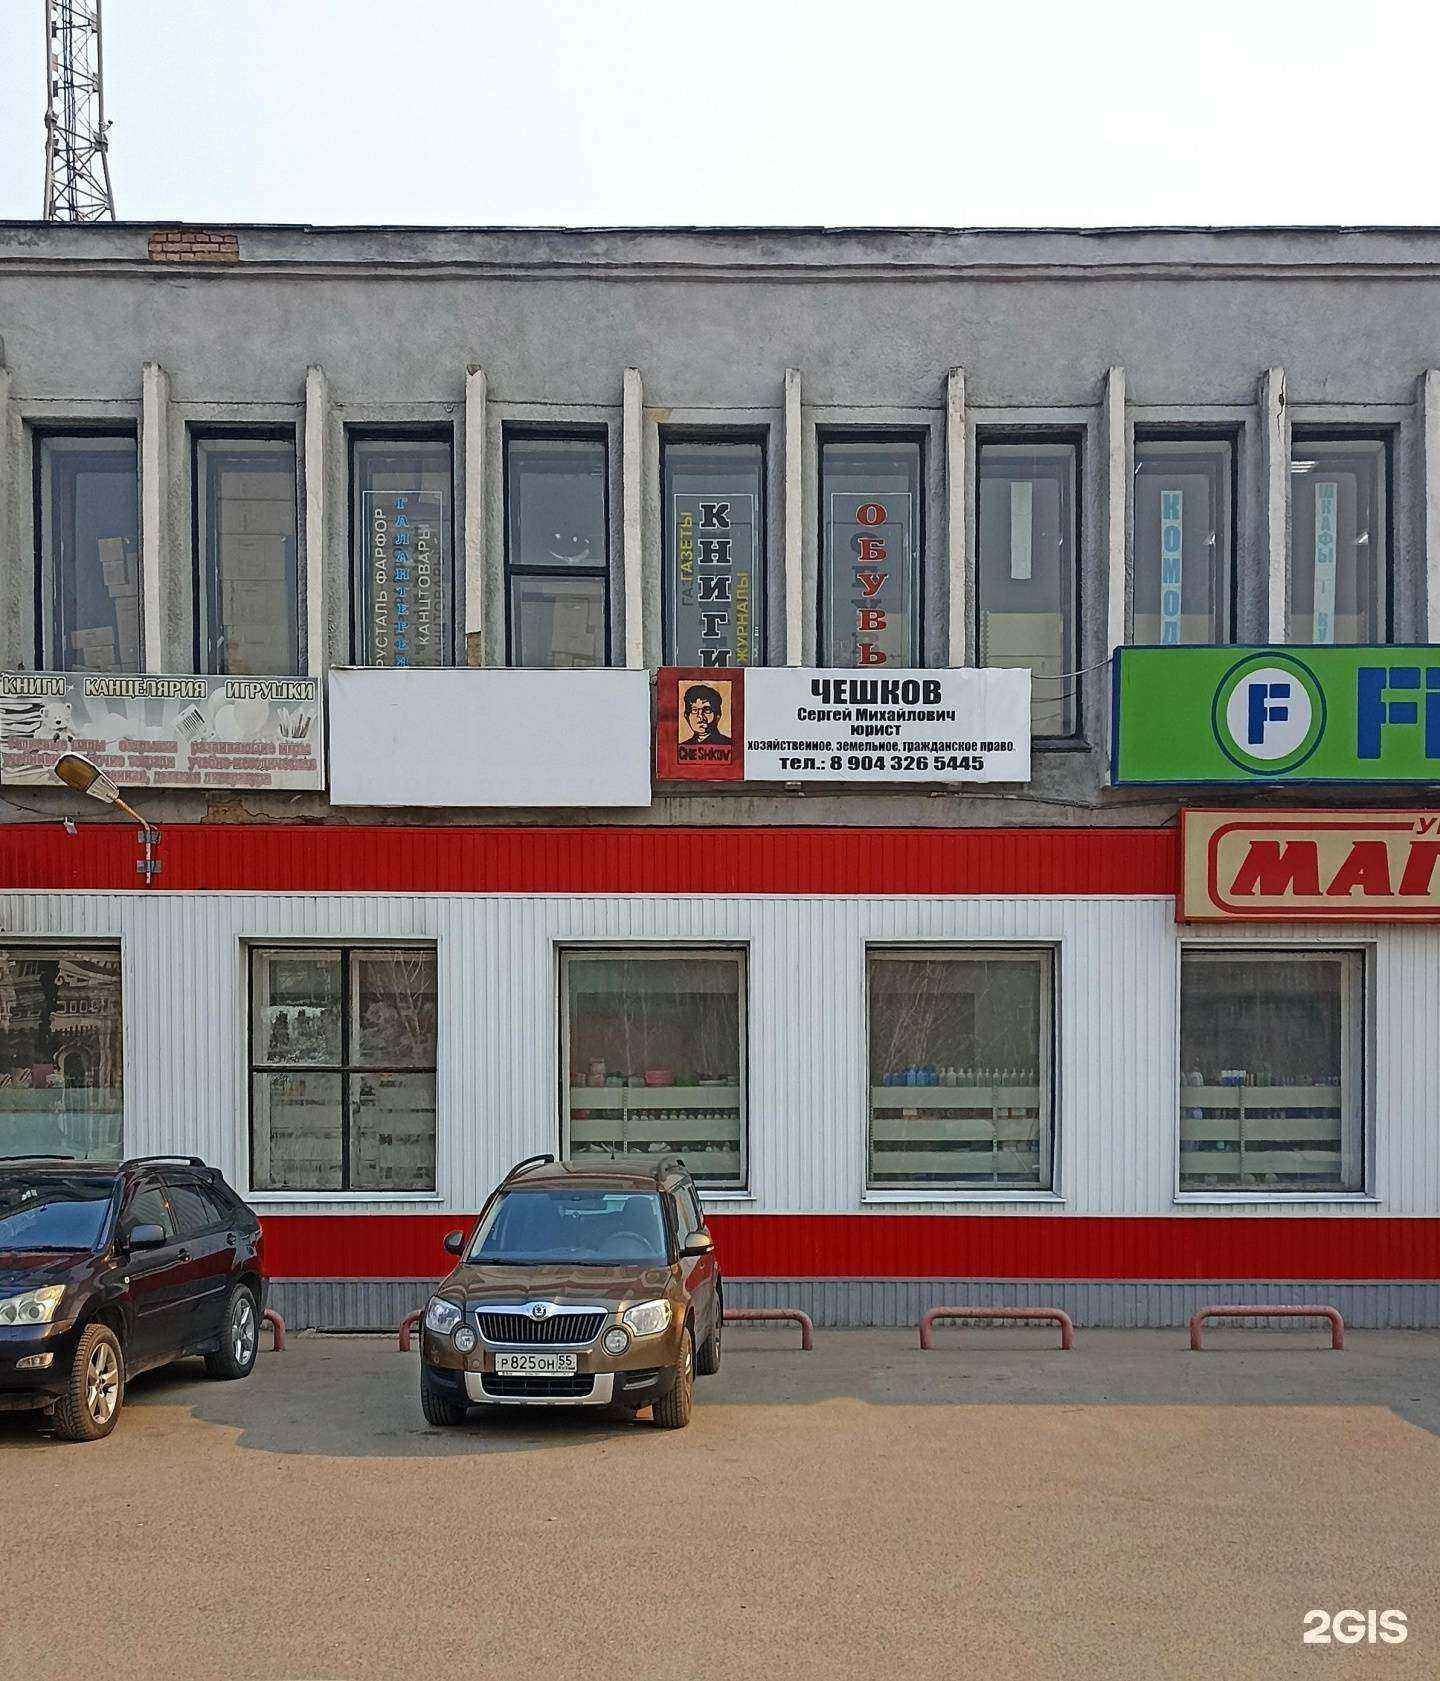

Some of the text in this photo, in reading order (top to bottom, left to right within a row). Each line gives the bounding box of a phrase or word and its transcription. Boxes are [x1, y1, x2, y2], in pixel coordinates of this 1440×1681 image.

[375, 508, 387, 584] ФАРФОР
[680, 511, 694, 580] ГАЗЕТЫ
[418, 524, 431, 645] КАНЦТОВАРЫ
[698, 503, 732, 667] КНИГИ
[736, 570, 750, 662] ЖУРНАЛЫ
[856, 502, 888, 666] ОБУВЬ
[2, 676, 315, 701] КНИГИ КАНЦЕЛЯРИЯ ИГРУШКИ
[797, 706, 956, 724] Сергей Михайлович
[810, 679, 943, 705] ЧЕШКОВ
[1248, 683, 1291, 744] F
[829, 755, 843, 772] 8
[847, 755, 886, 772] 904
[890, 755, 930, 772] 326
[933, 755, 985, 772] 5445
[902, 741, 978, 754] гражданское
